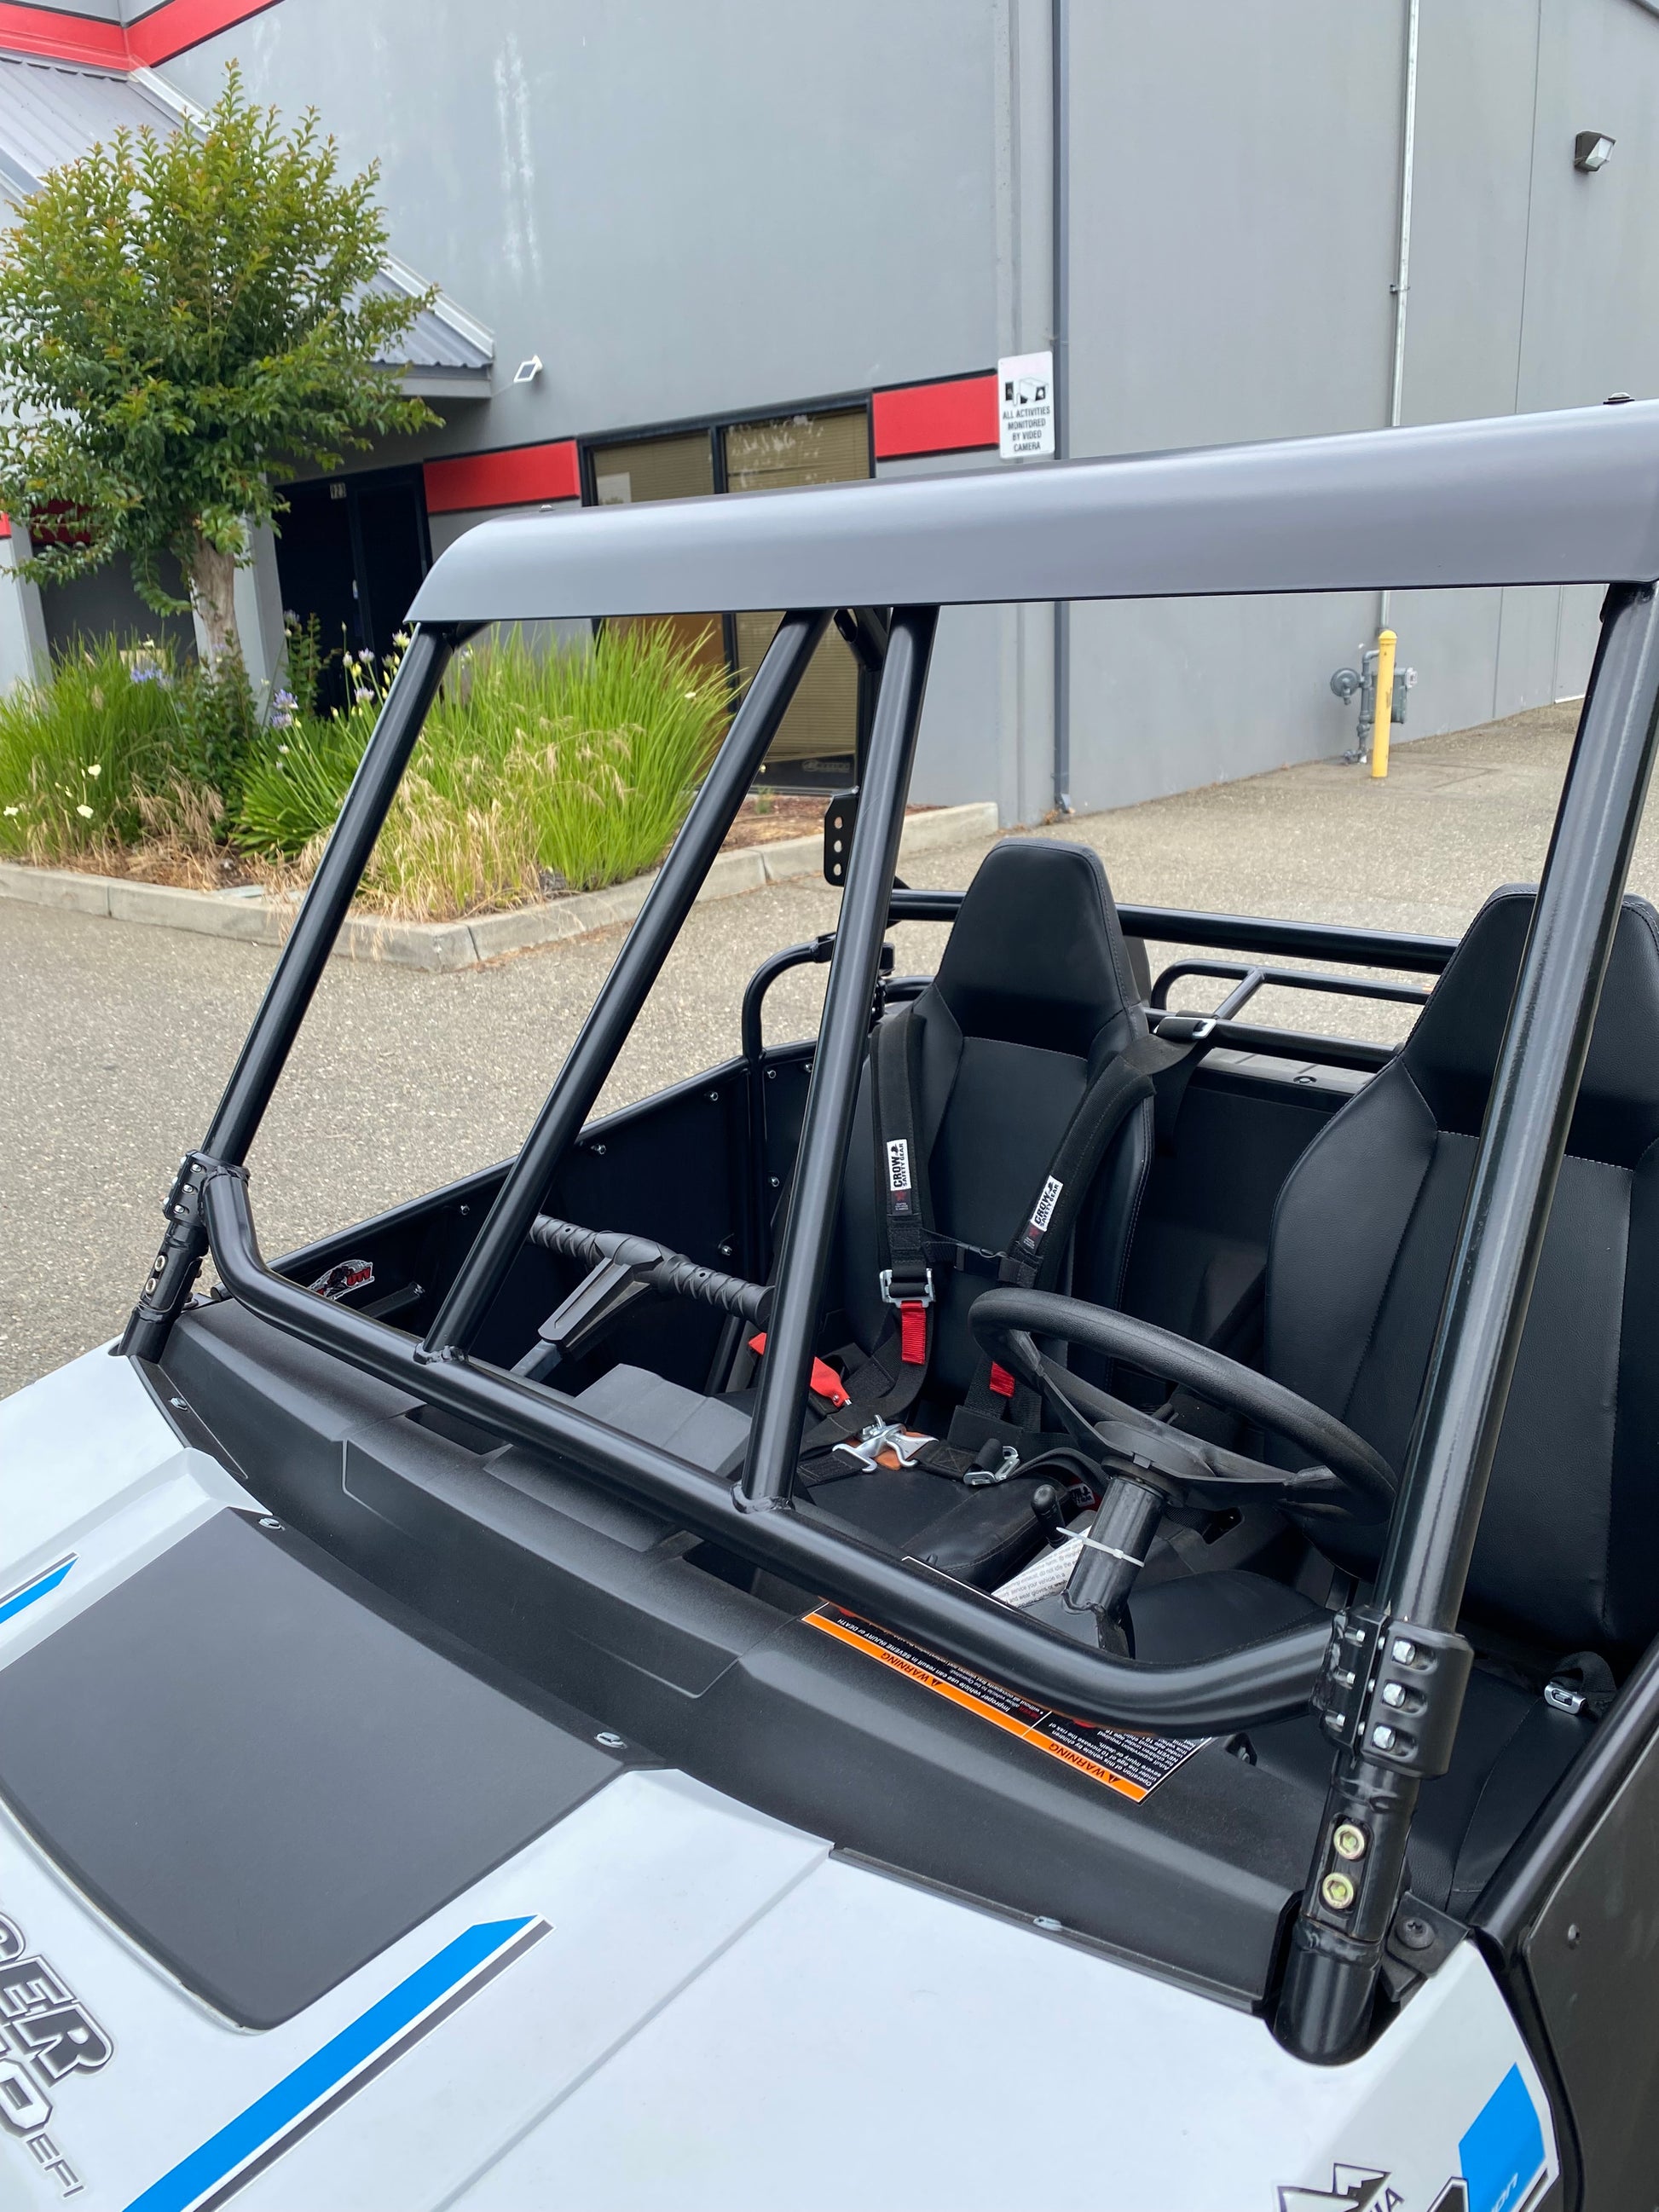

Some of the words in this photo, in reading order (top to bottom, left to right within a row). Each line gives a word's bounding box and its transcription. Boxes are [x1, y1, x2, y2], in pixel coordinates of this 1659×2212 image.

[1003, 410, 1014, 419] ALL
[1016, 406, 1050, 418] ACTIVITIES
[1008, 418, 1046, 430] MONITORED
[1013, 432, 1021, 441] BY
[1022, 430, 1042, 440] VIDEO
[1014, 442, 1041, 452] CAMERA
[892, 1156, 902, 1187] CROW
[1034, 1192, 1049, 1225] CROW
[1040, 1203, 1051, 1227] SAFETY
[1049, 1184, 1059, 1202] GEAR
[1038, 1576, 1055, 1585] vehicle
[836, 1618, 858, 1631] DEATH
[864, 1632, 887, 1645] INJURY
[885, 1643, 911, 1659] SEVERE
[879, 1652, 931, 1681] WARNING
[916, 1660, 935, 1672] result
[934, 1669, 947, 1678] can
[945, 1675, 959, 1684] use
[957, 1682, 981, 1696] vehicle
[986, 1689, 1005, 1701] vehicle
[980, 1693, 1011, 1711] Improper
[1004, 1698, 1020, 1707] allow
[1050, 1730, 1075, 1744] children
[1096, 1730, 1121, 1745] required
[1076, 1737, 1101, 1752] increase
[1124, 1739, 1142, 1749] under
[1137, 1739, 1158, 1751] permit
[1172, 1739, 1192, 1751] permit
[1082, 1747, 1103, 1759] vehicle
[1120, 1742, 1154, 1761] supervision
[1141, 1747, 1165, 1761] children
[1156, 1749, 1178, 1762] NEVER
[1165, 1747, 1182, 1758] under
[1048, 1743, 1105, 1776] WARNING
[1102, 1758, 1115, 1766] this
[1123, 1754, 1142, 1766] injury
[1152, 1760, 1169, 1770] Adult
[1137, 1770, 1157, 1781] under
[1140, 1764, 1161, 1776] severe
[1120, 1768, 1153, 1786] Operation
[26, 2133, 84, 2198] EFI
